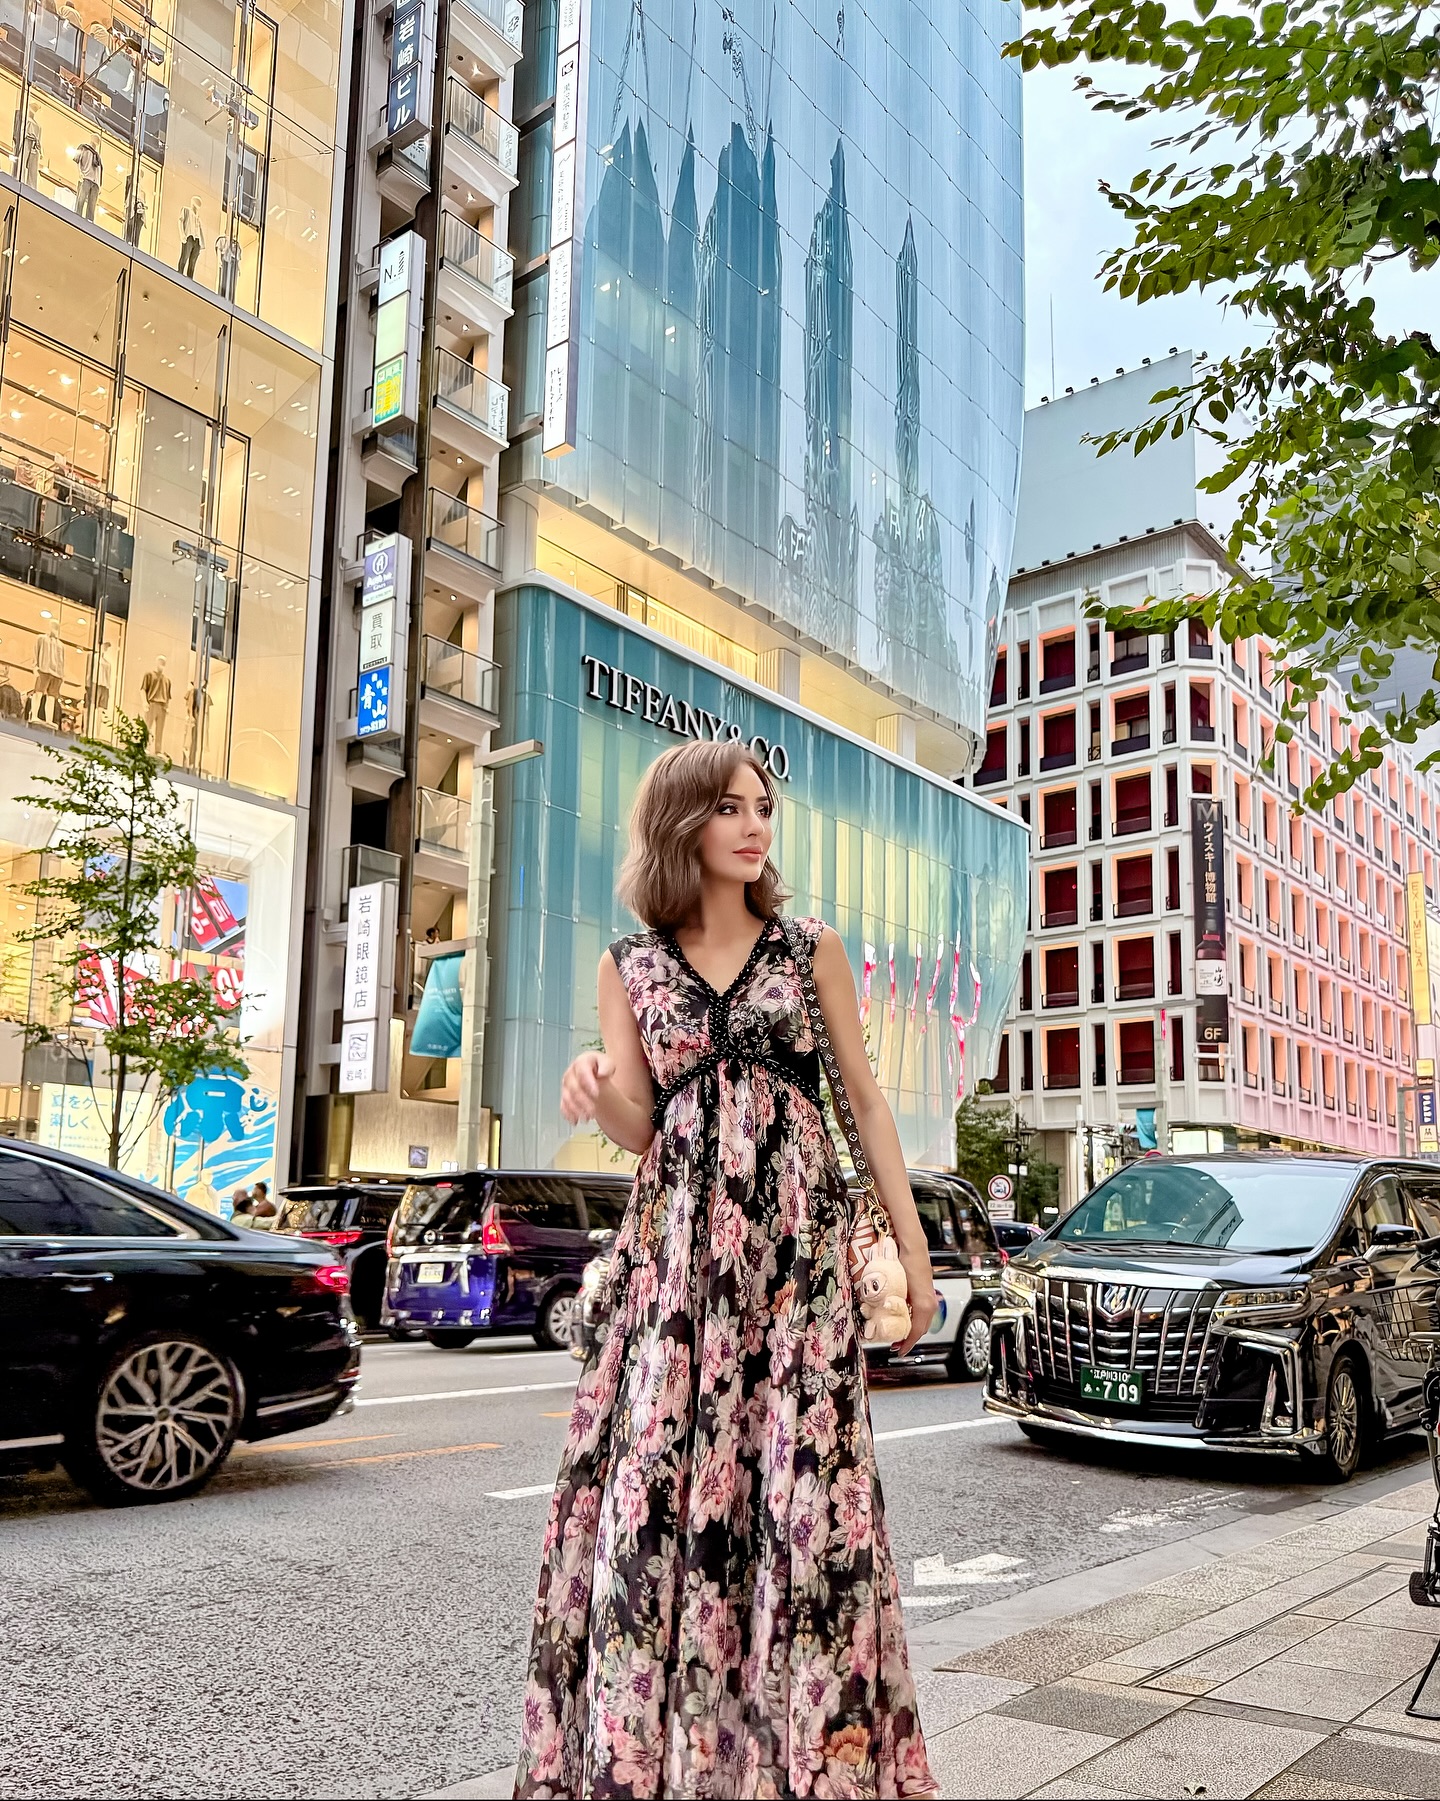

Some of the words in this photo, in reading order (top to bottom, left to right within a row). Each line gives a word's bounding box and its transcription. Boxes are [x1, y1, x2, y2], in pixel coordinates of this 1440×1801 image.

[393, 15, 415, 131] 岩崎ビル
[370, 612, 383, 650] 買取
[360, 683, 387, 719] 青山
[1203, 821, 1217, 904] ウイスキー博物館
[353, 894, 373, 1009] 岩崎眼鏡店
[1204, 1027, 1222, 1041] 6F
